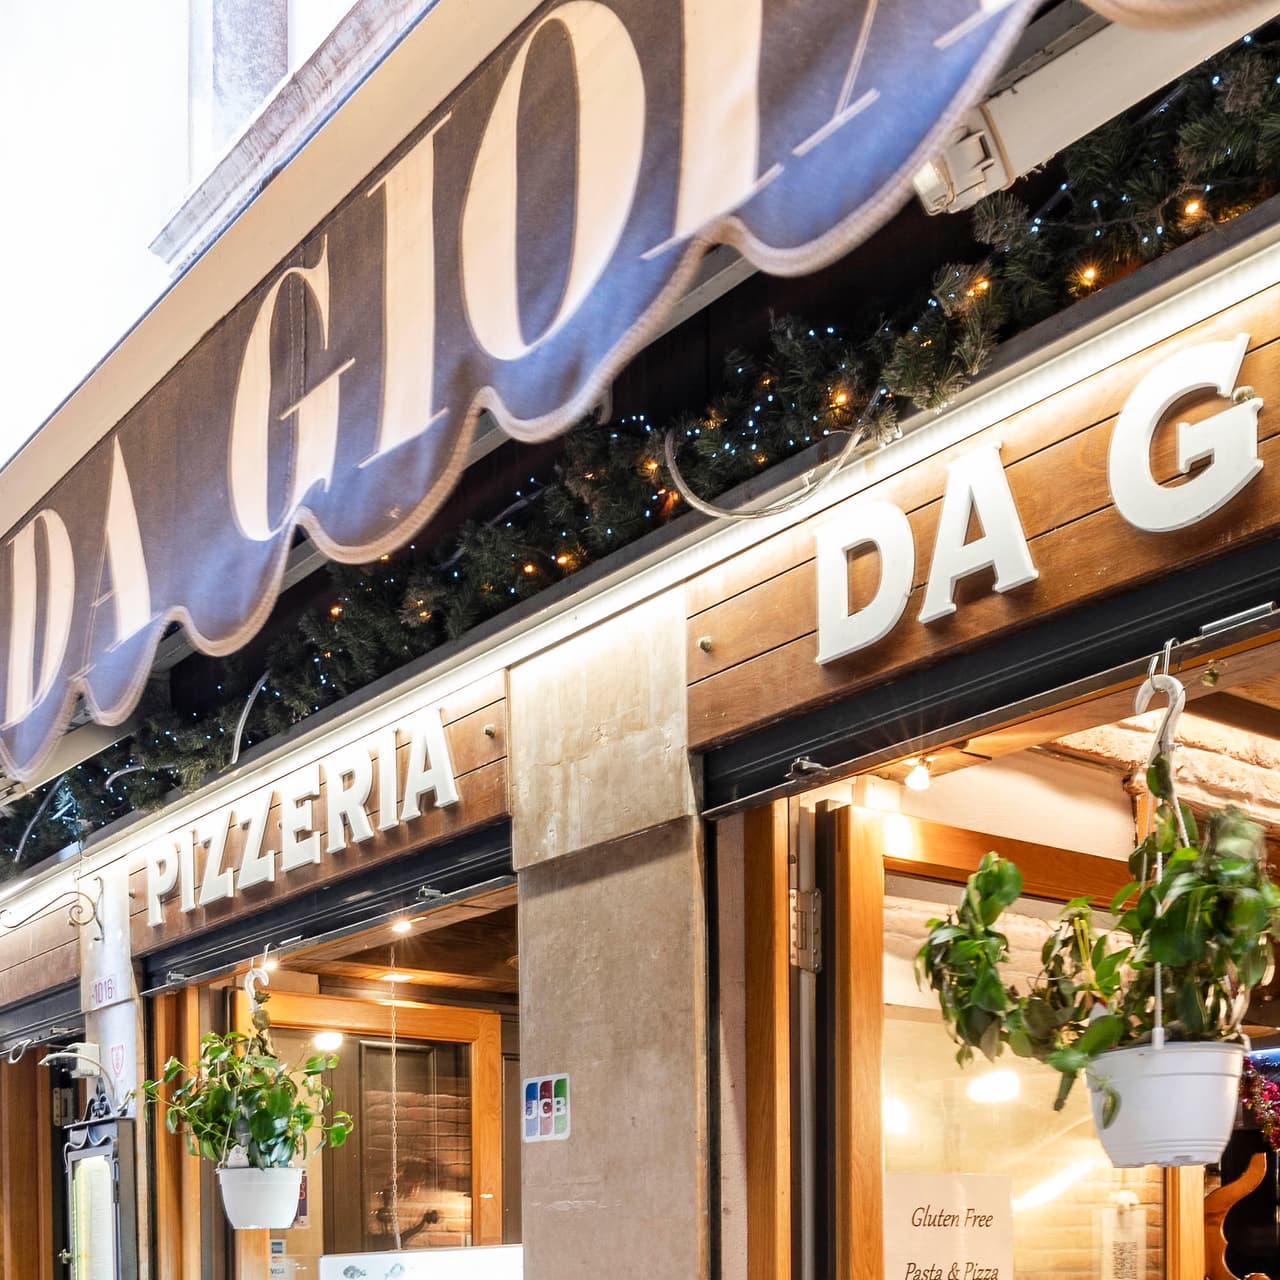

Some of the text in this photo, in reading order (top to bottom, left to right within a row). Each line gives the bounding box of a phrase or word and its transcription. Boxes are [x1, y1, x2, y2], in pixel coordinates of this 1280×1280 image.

[227, 0, 1018, 541] GIOI
[815, 440, 1040, 665] DA
[145, 707, 459, 928] PIZZERIA
[94, 978, 113, 1005] 1016
[525, 1097, 567, 1120] JCB
[911, 1204, 994, 1228] Gluten Free
[963, 1261, 1000, 1280] Pizza
